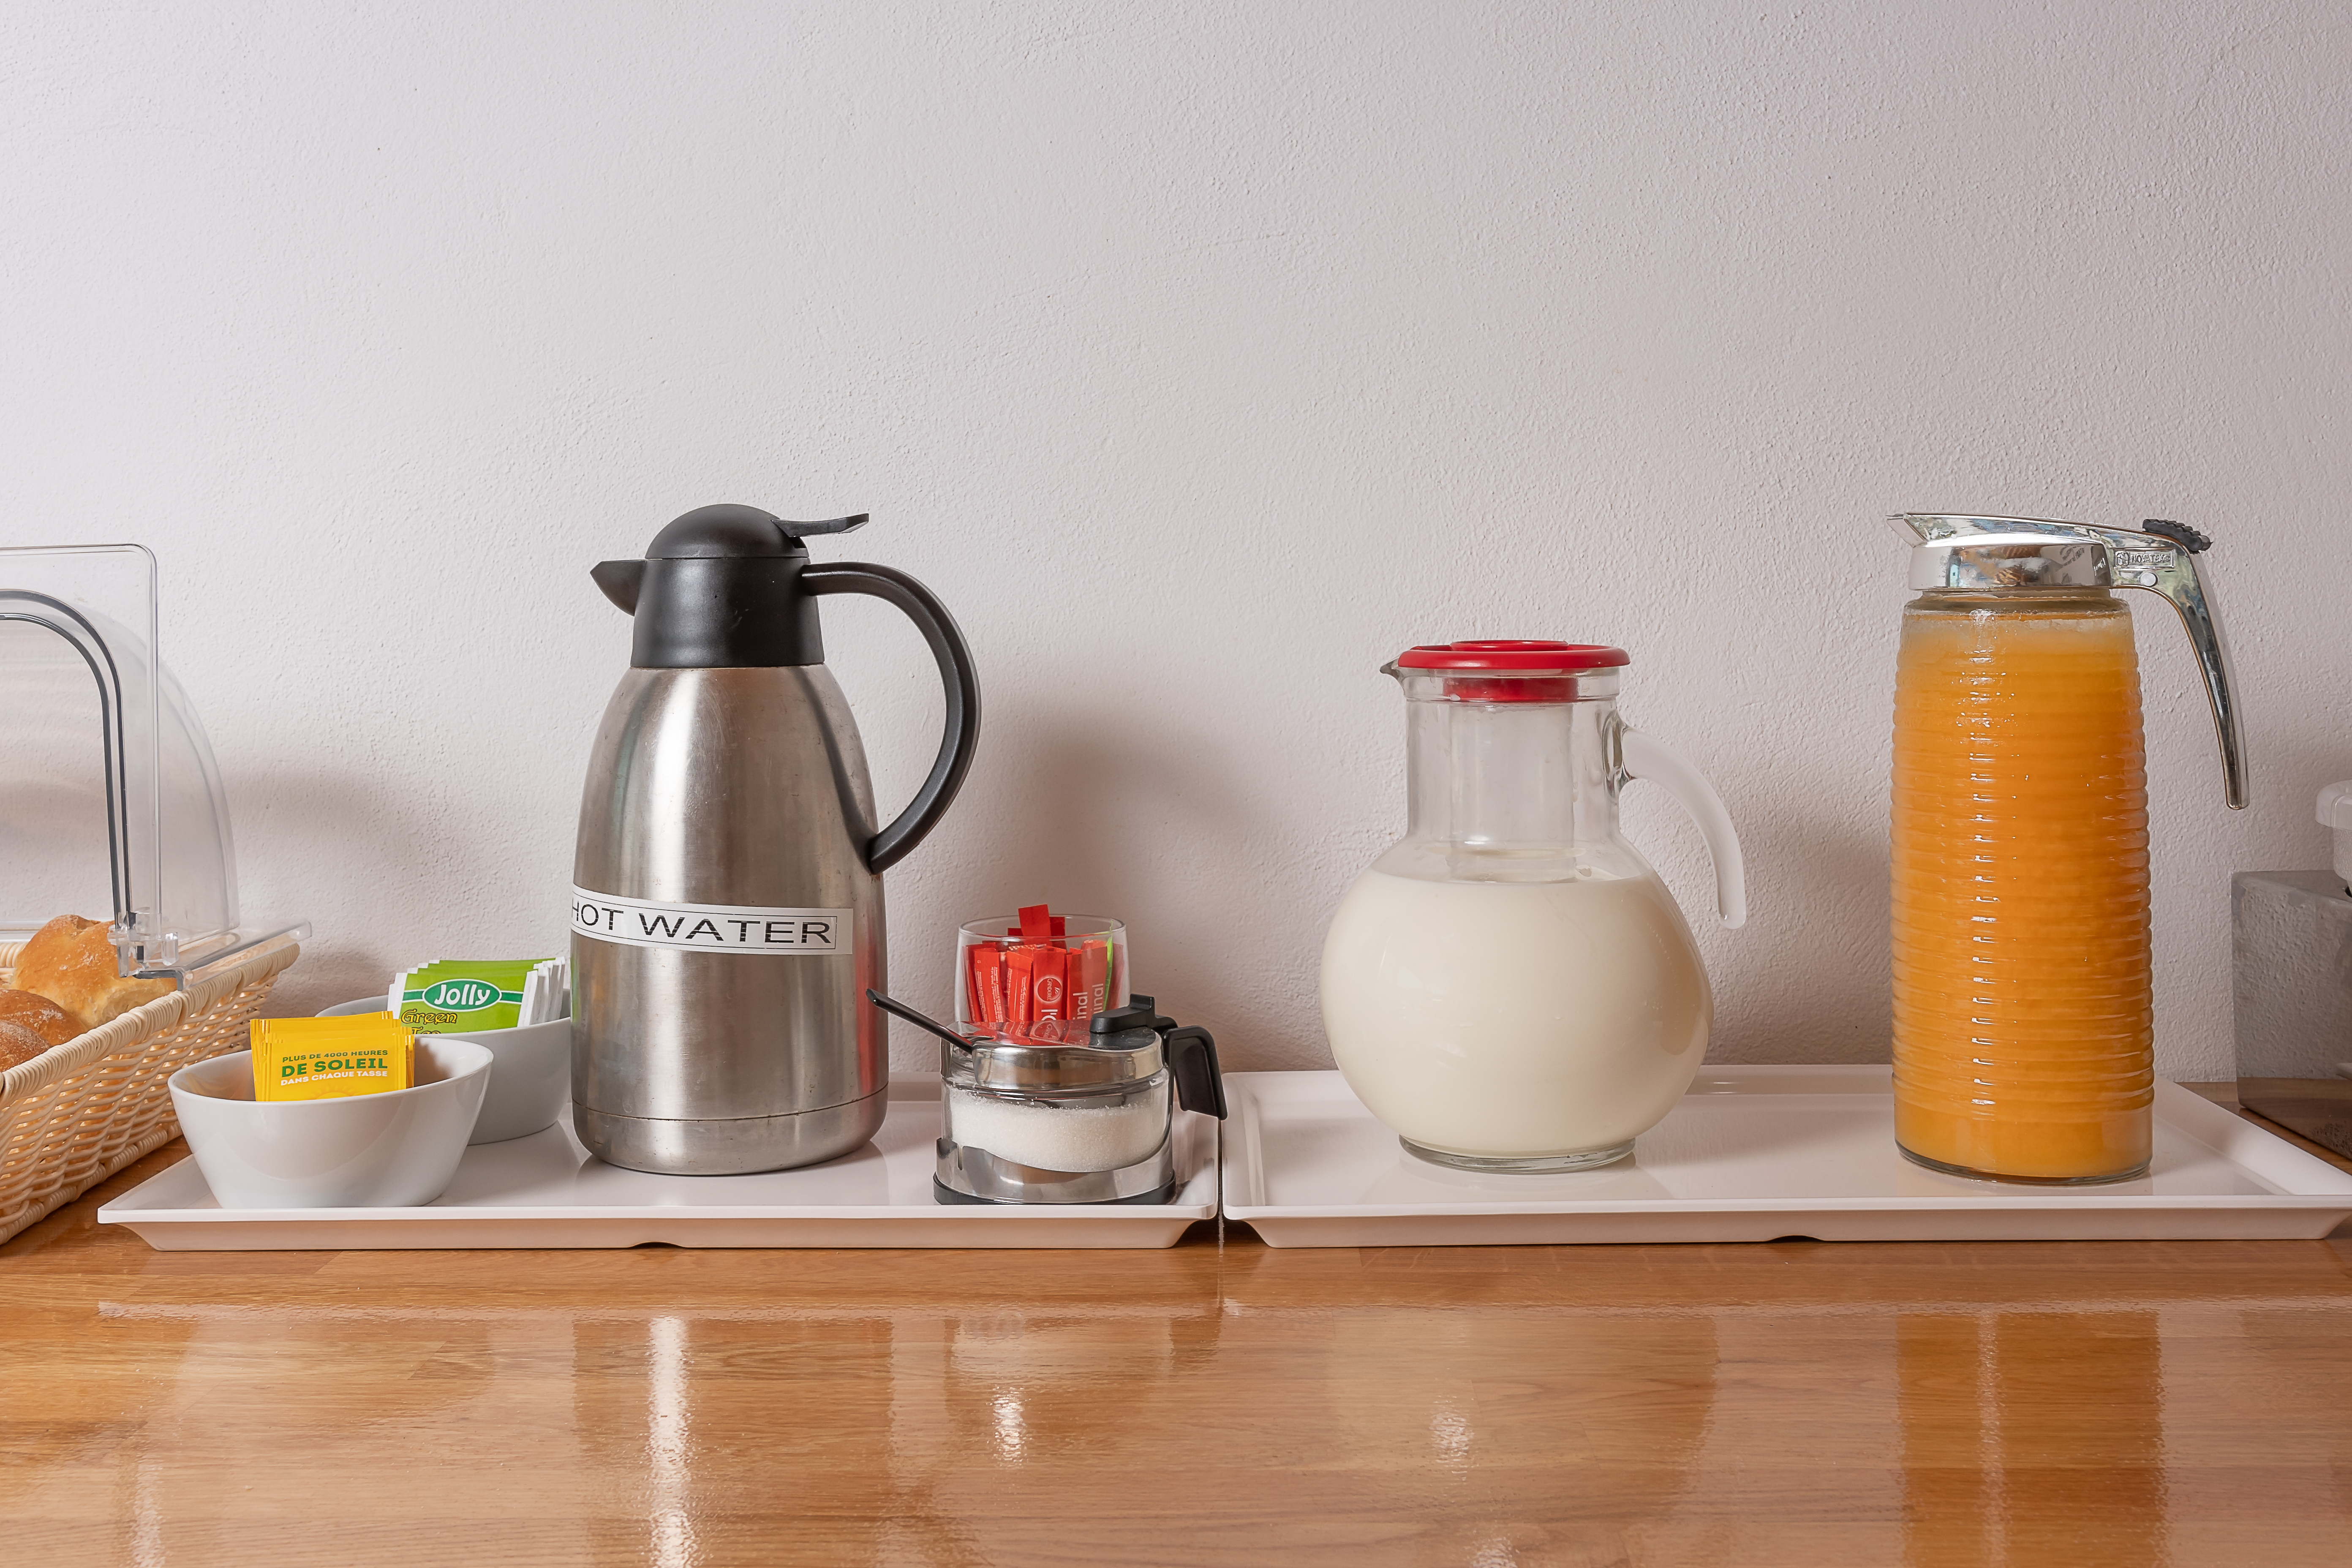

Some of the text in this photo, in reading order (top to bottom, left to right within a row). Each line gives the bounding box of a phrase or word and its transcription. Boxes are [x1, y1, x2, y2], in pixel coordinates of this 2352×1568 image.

[571, 897, 831, 943] HOT WATER
[434, 984, 490, 1006] Jolly
[401, 1009, 457, 1025] Green
[282, 1058, 388, 1077] DE SOLEIL
[280, 1076, 309, 1086] DANS
[311, 1071, 354, 1081] CHAQUE
